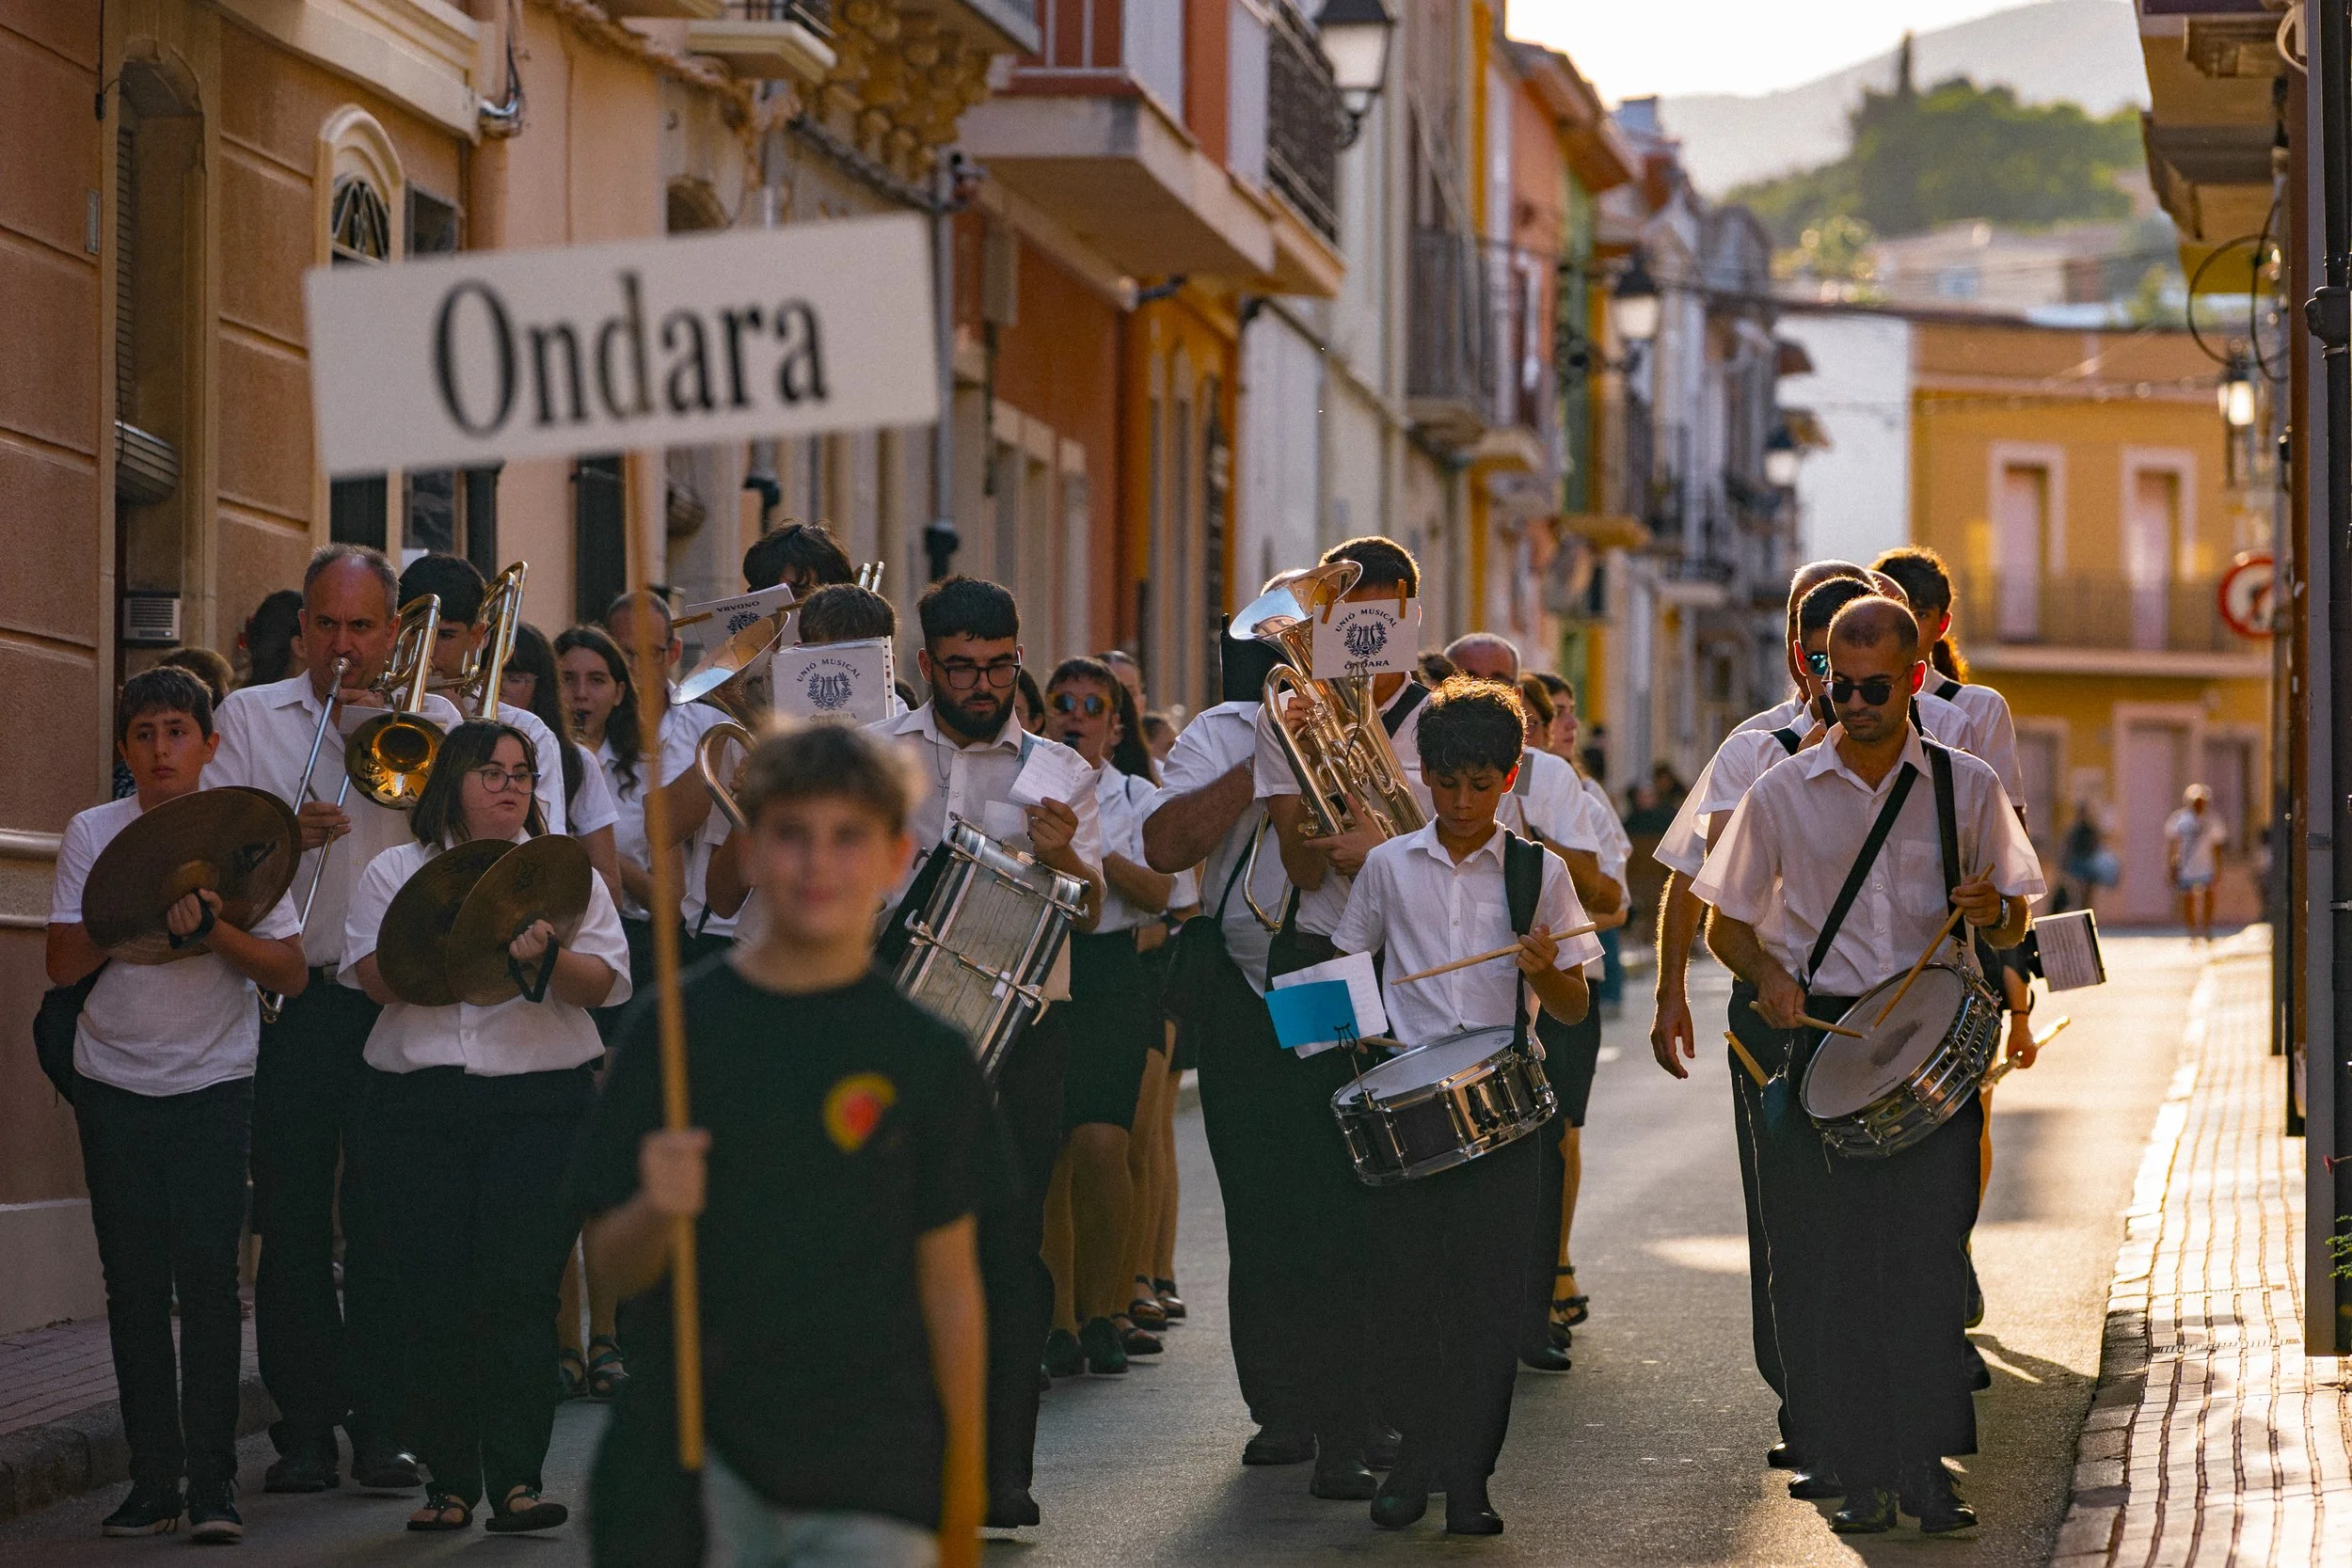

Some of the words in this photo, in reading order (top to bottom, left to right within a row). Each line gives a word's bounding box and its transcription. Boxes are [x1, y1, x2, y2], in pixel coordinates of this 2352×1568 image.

[434, 269, 827, 438] Ondara
[716, 601, 759, 613] ONDARA
[1360, 609, 1397, 628] MUSICAL
[821, 658, 861, 680] MUSICAL
